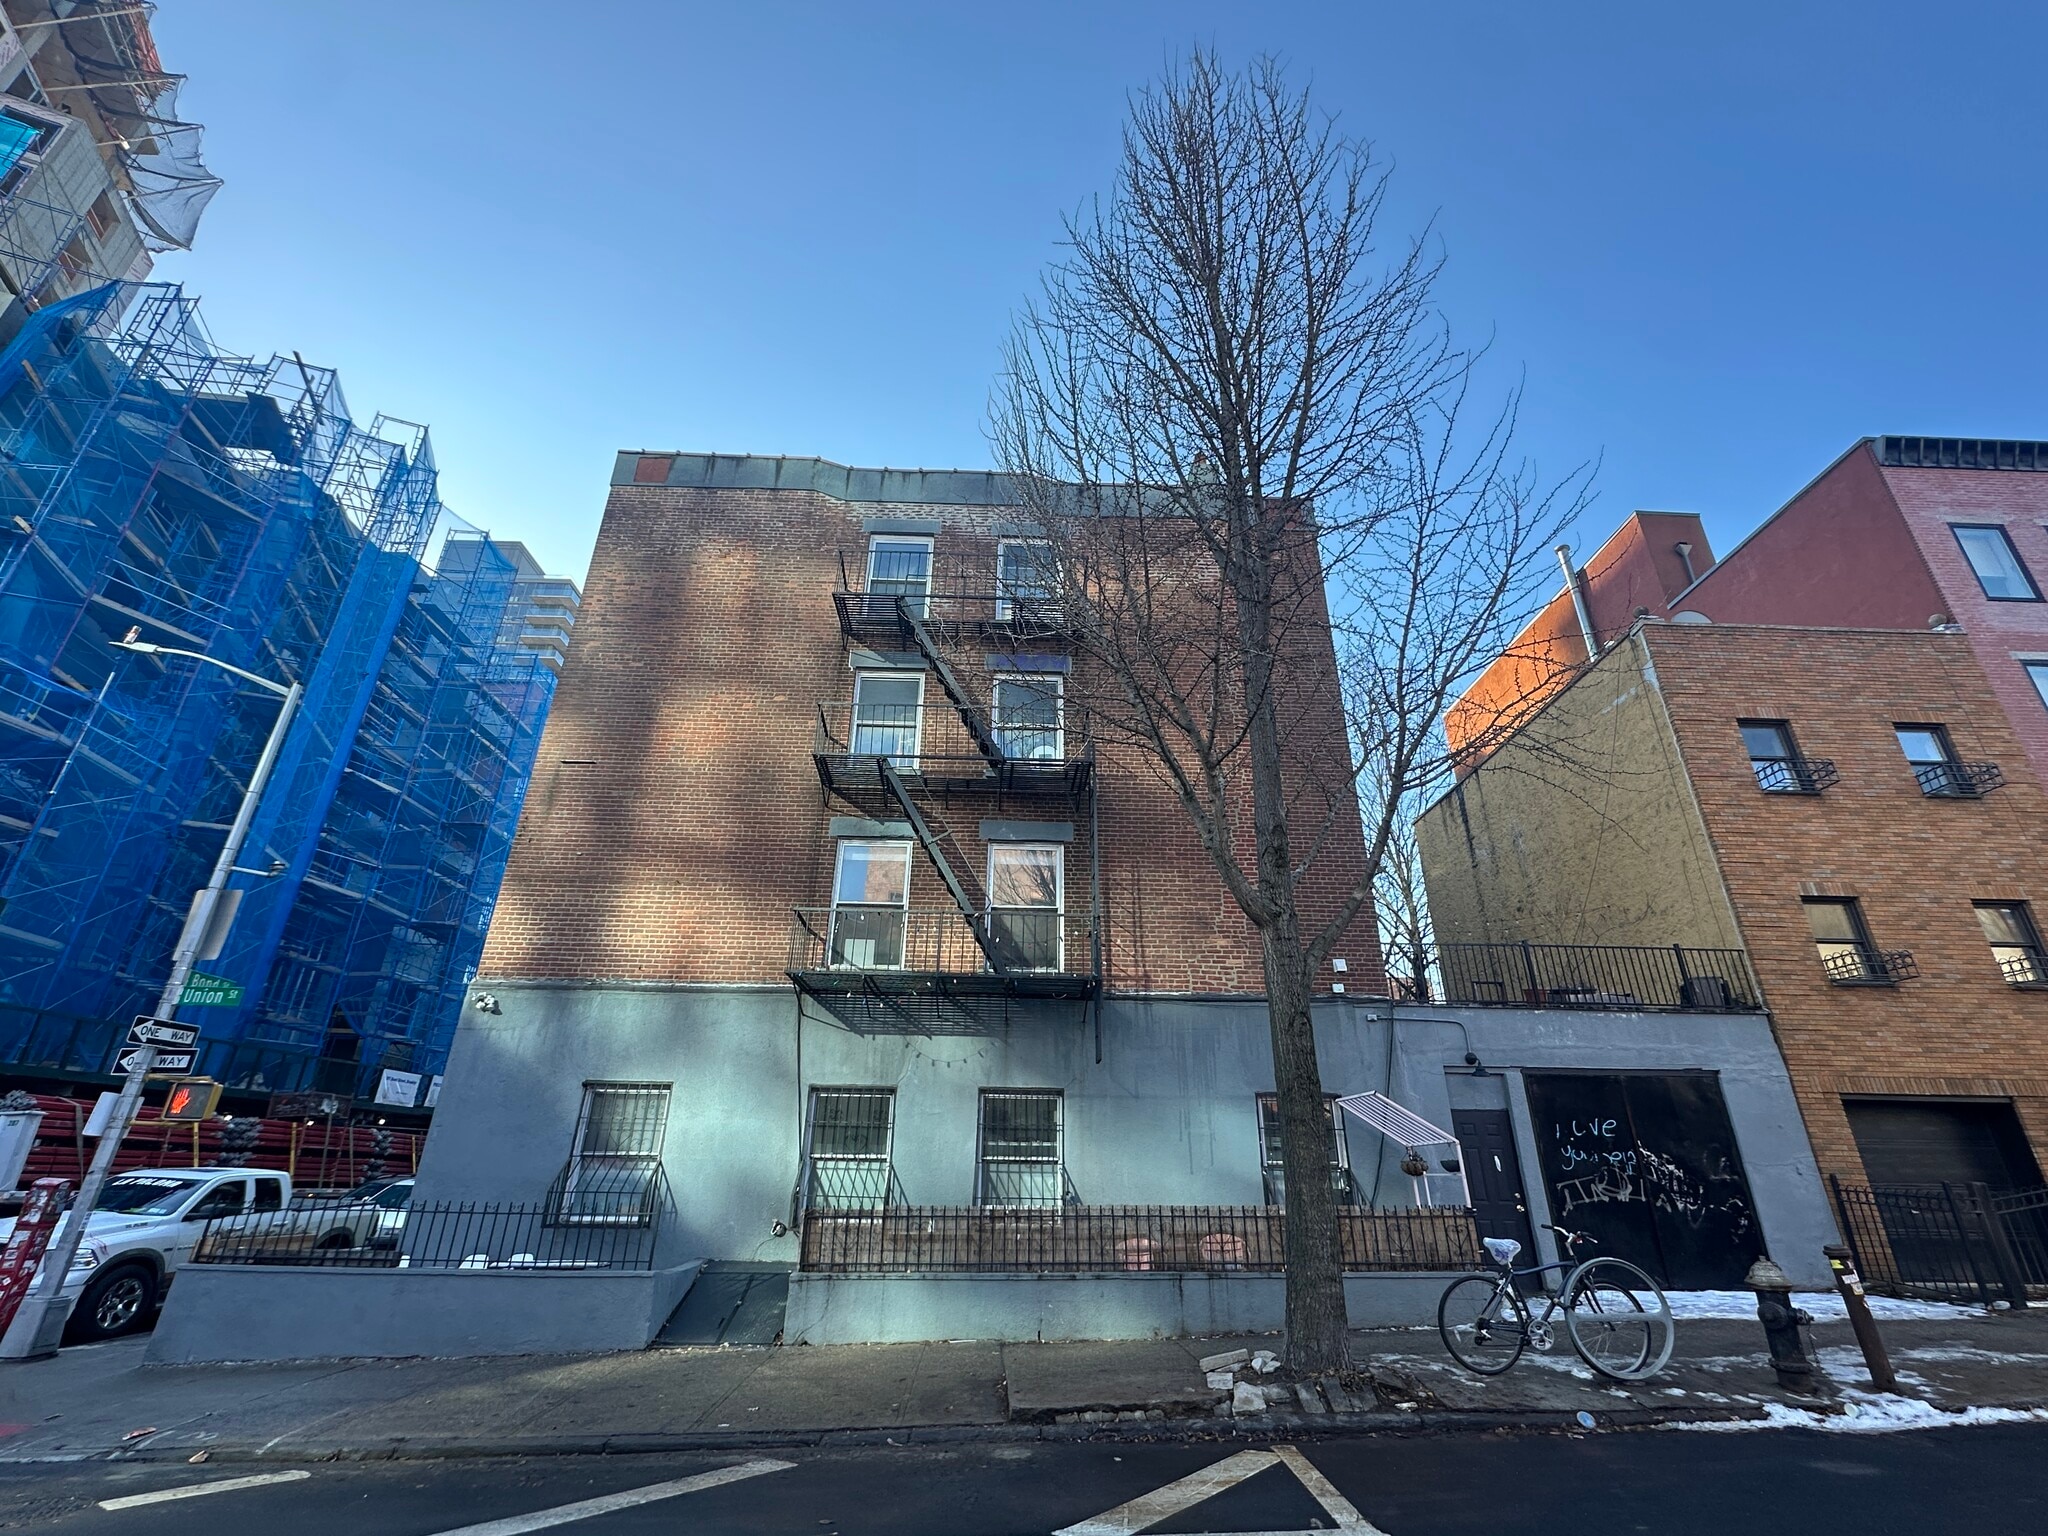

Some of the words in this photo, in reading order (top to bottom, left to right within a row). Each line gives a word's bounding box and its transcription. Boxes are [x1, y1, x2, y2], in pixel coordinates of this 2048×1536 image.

[191, 973, 221, 988] Bond
[183, 988, 224, 1004] Union
[227, 989, 239, 999] St
[140, 1025, 162, 1038] ONE
[170, 1030, 193, 1042] WAY
[159, 1056, 185, 1066] WAY
